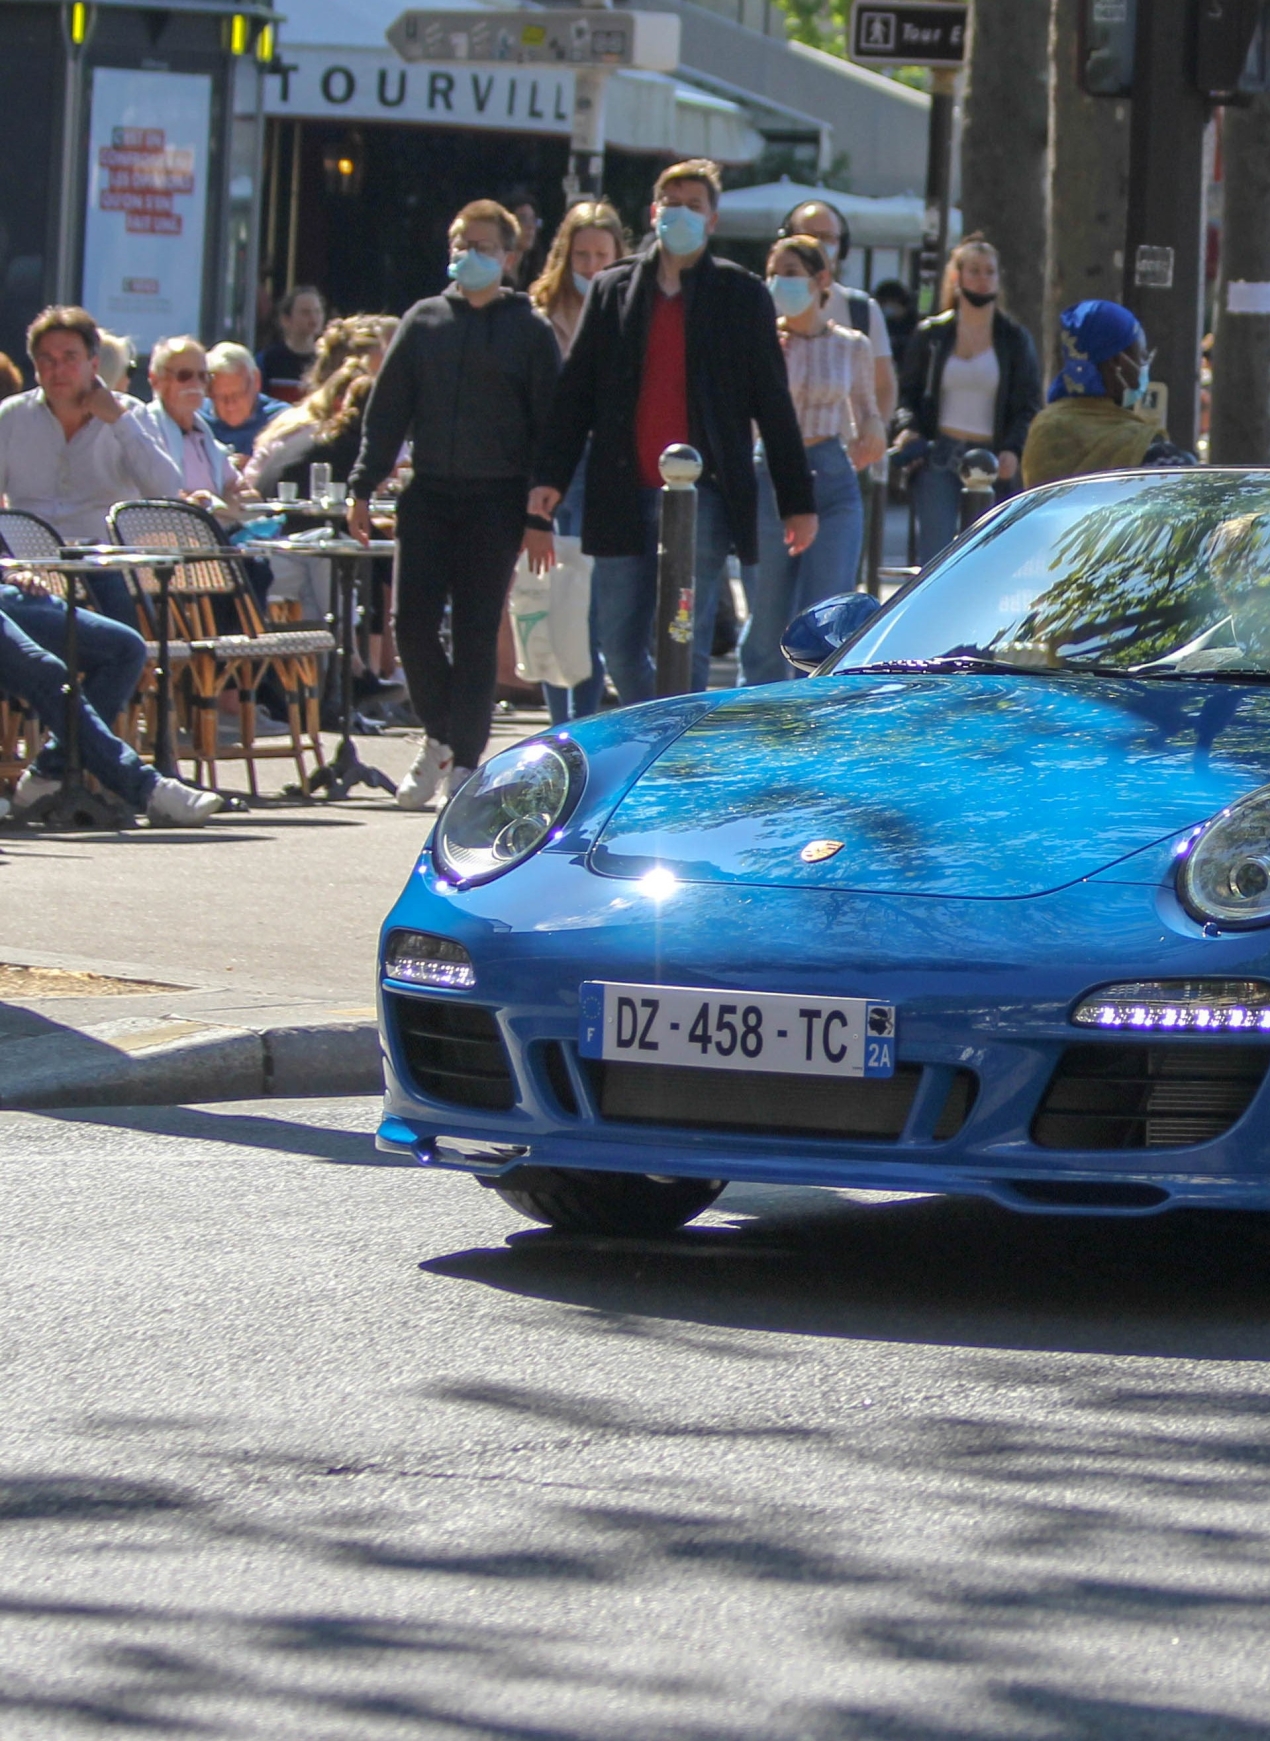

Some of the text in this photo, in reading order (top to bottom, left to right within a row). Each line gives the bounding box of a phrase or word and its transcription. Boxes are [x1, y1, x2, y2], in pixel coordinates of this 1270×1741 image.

[903, 23, 941, 41] Tour
[587, 1027, 595, 1042] F
[868, 1044, 890, 1068] 2A
